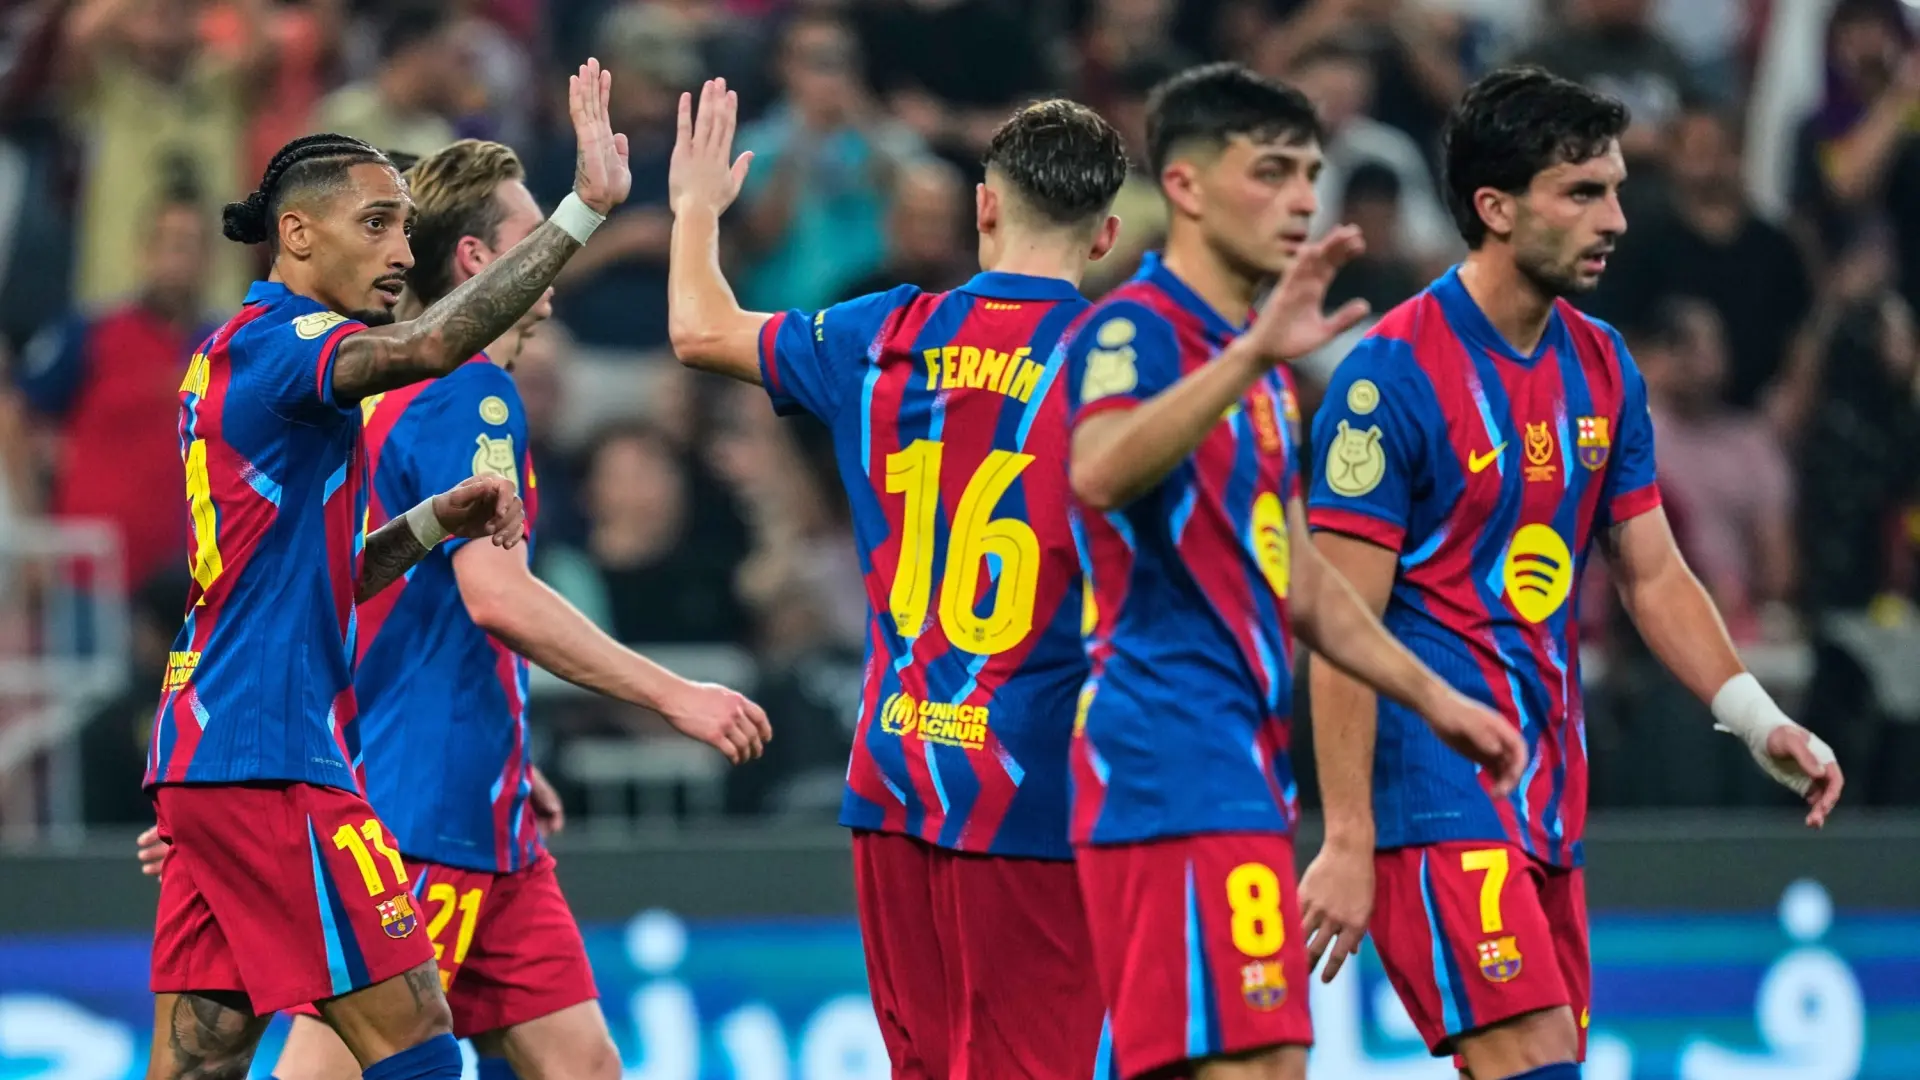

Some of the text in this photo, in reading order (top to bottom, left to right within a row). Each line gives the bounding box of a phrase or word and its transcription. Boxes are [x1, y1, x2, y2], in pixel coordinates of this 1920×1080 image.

[922, 346, 1045, 404] FERMÍN
[885, 438, 1040, 654] 16
[917, 716, 986, 742] ACNUR
[918, 700, 989, 724] UNHCR
[332, 819, 408, 897] 11
[1460, 849, 1509, 933] 7
[426, 883, 483, 969] 21
[1226, 862, 1284, 957] 8
